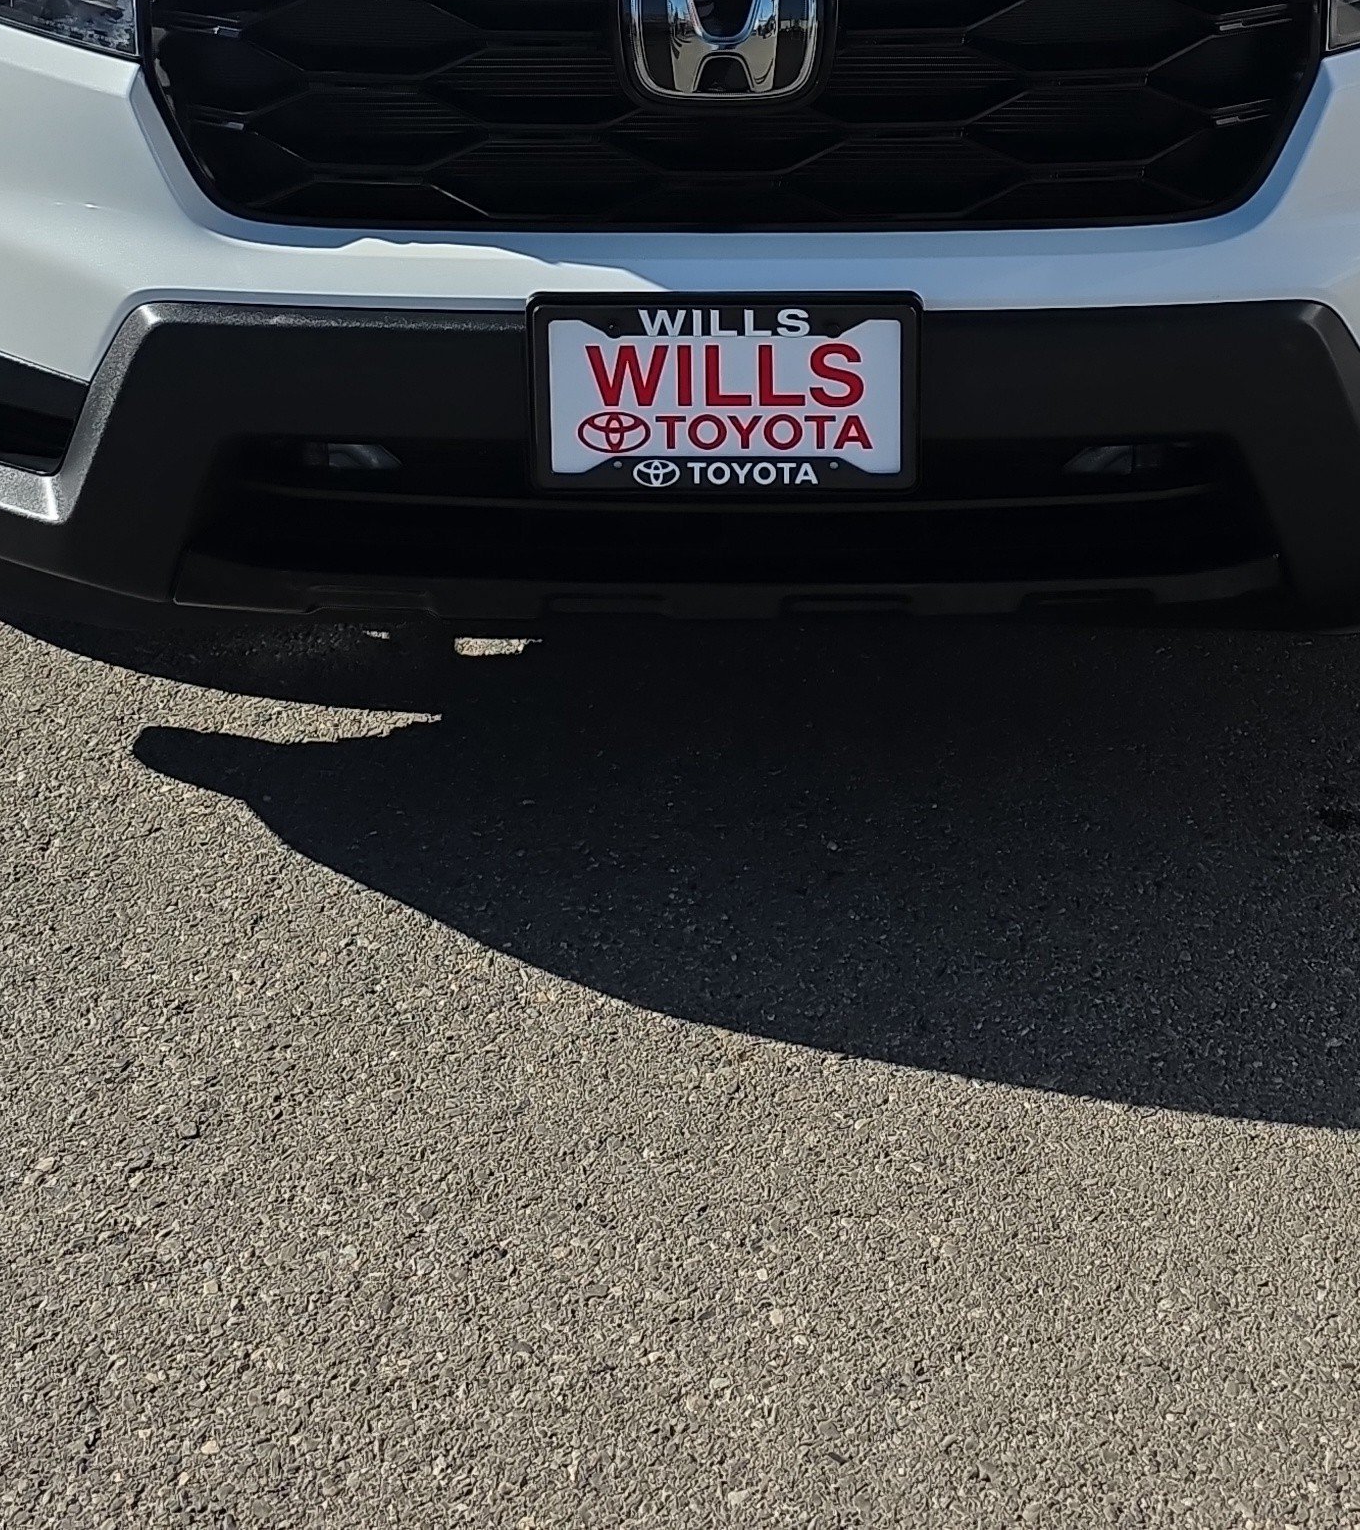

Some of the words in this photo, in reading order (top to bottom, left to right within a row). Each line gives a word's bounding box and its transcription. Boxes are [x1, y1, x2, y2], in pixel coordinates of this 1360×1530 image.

[638, 308, 811, 338] WILLS
[585, 343, 865, 408] WILLS
[654, 414, 874, 450] TOYOTA
[687, 461, 819, 486] TOYOTA
